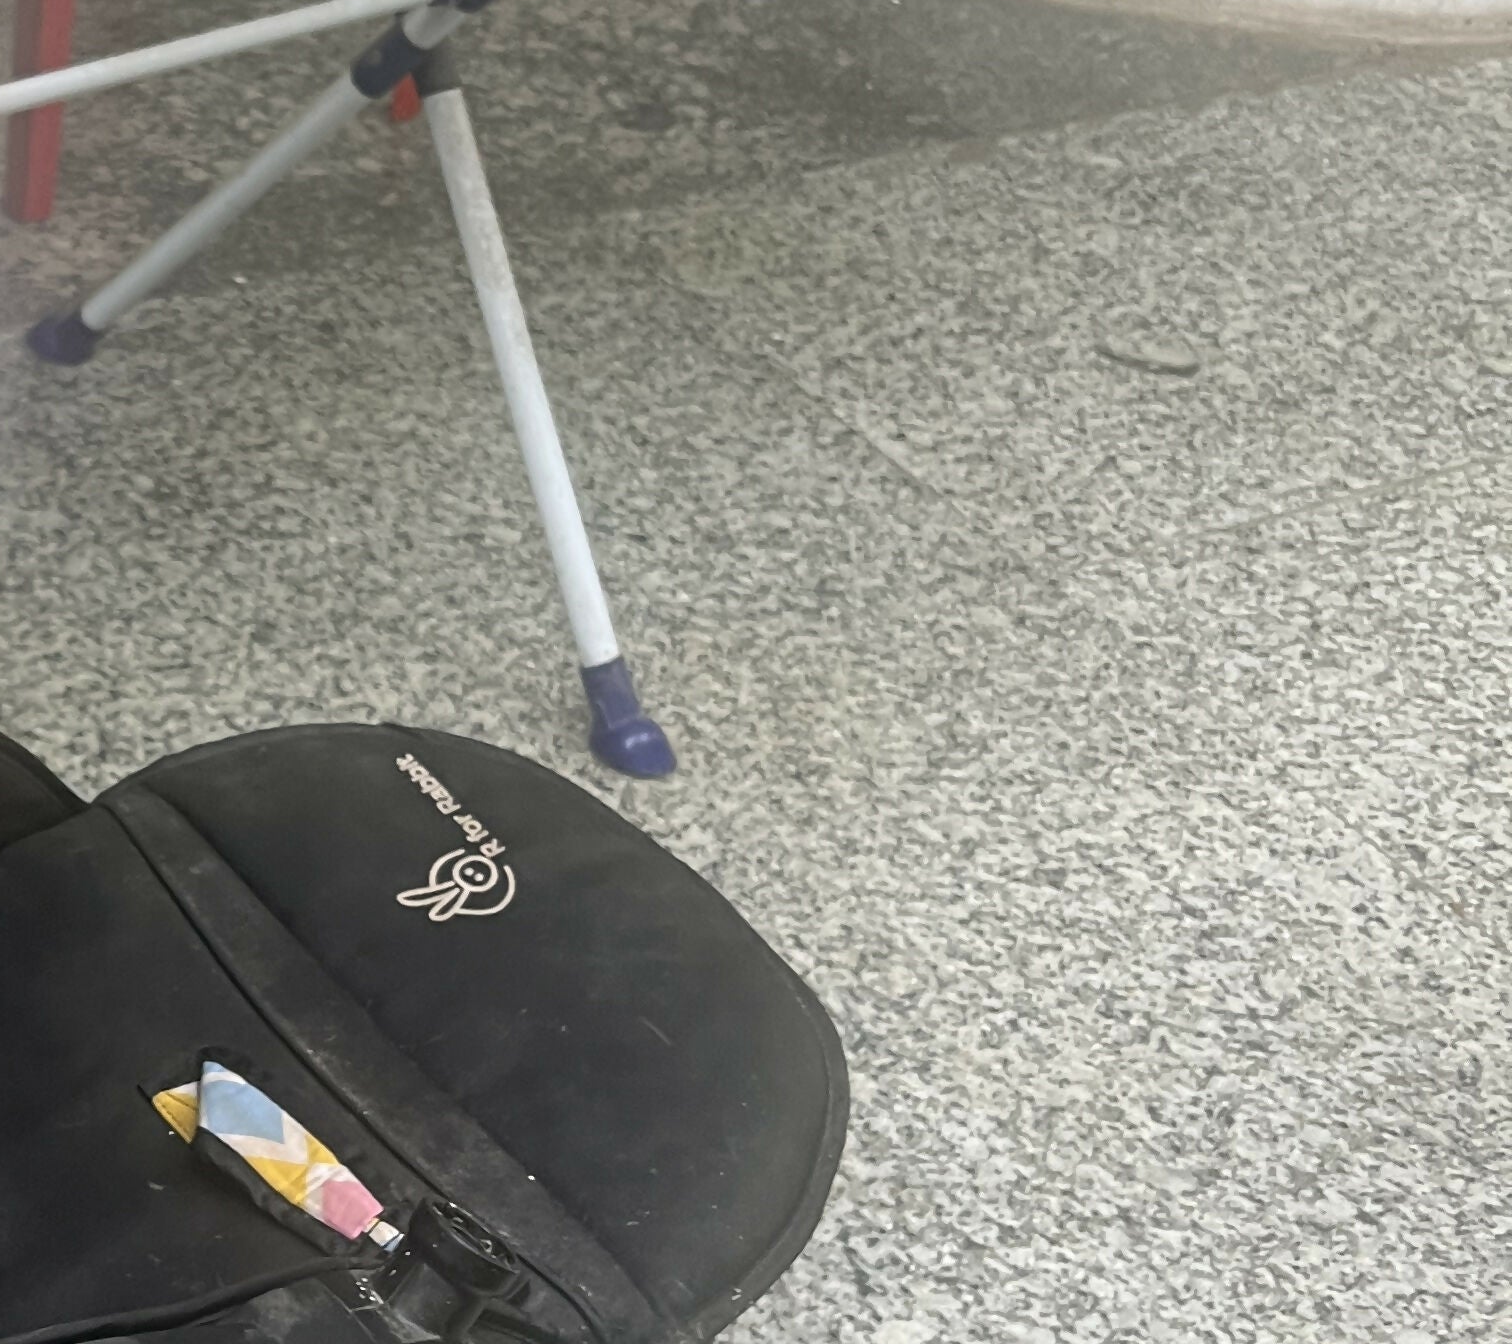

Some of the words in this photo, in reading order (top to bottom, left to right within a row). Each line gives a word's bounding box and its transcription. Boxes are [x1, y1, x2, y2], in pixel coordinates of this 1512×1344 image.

[395, 753, 462, 815] Rabbit
[453, 814, 489, 842] for
[479, 838, 506, 857] R
